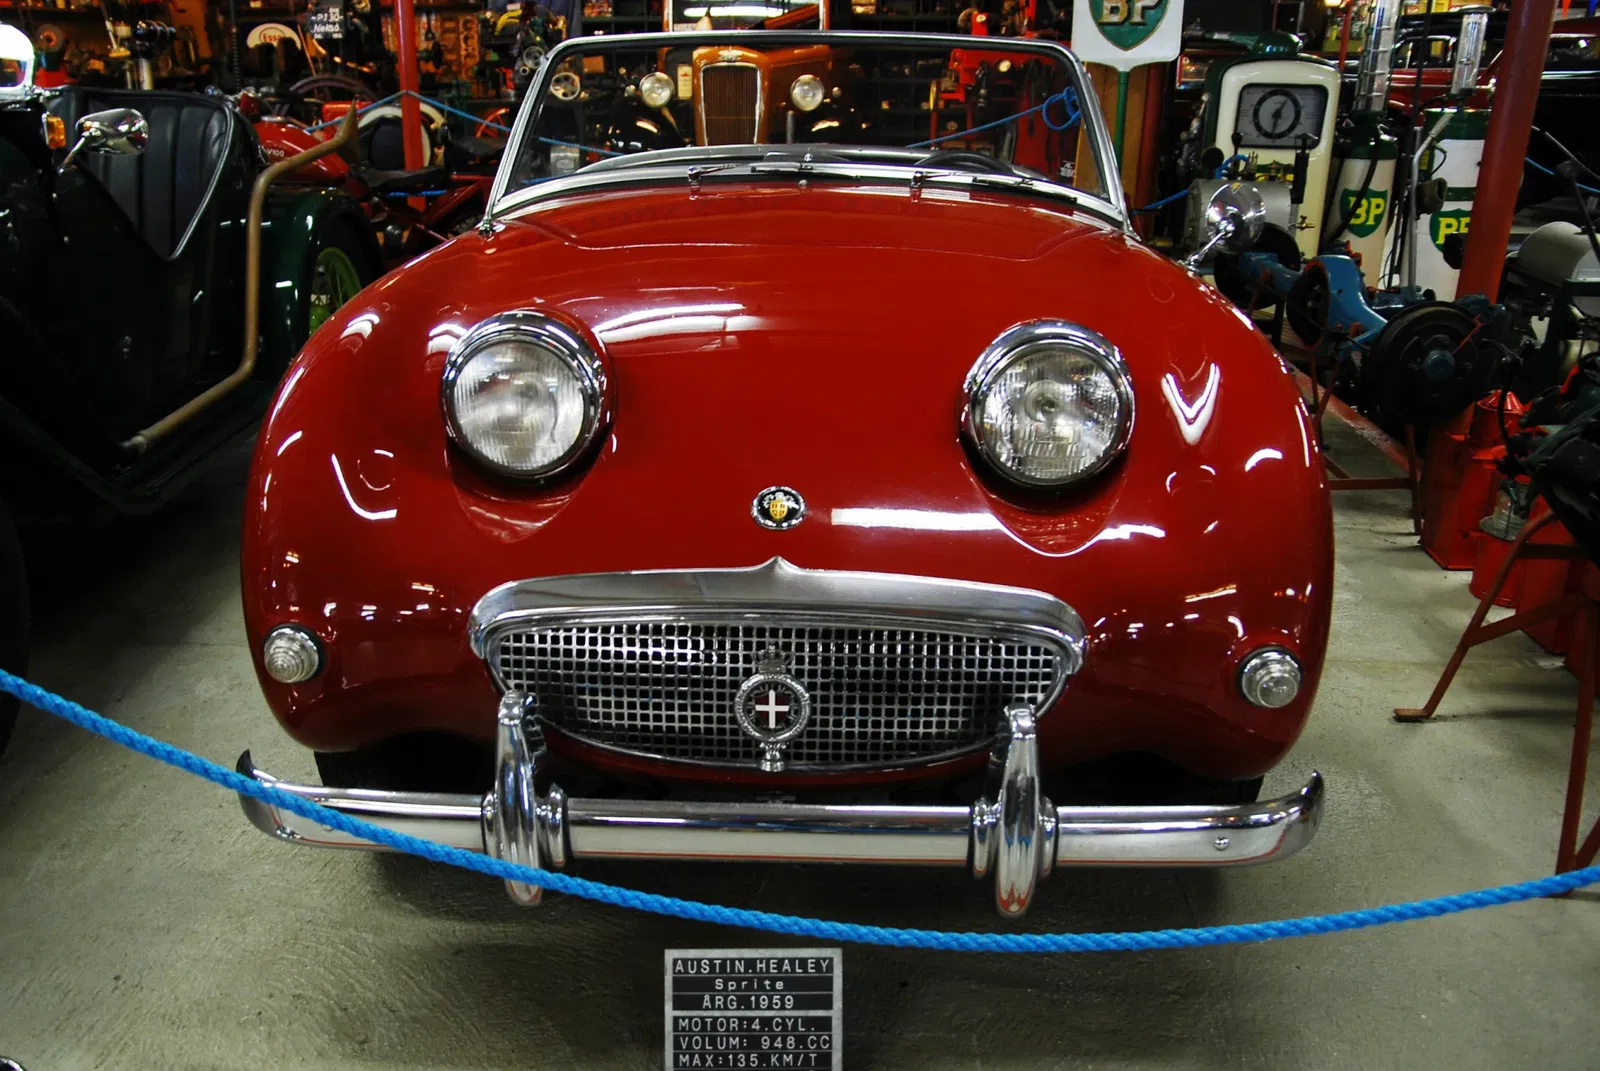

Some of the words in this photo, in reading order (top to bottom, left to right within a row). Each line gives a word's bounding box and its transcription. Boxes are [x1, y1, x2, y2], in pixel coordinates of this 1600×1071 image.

[1348, 196, 1386, 225] BP
[714, 978, 784, 991] Sprite
[679, 1035, 748, 1050] VOLUM:
[760, 1035, 831, 1050] 948.CC
[679, 1053, 818, 1068] MAX:135.KM/T
